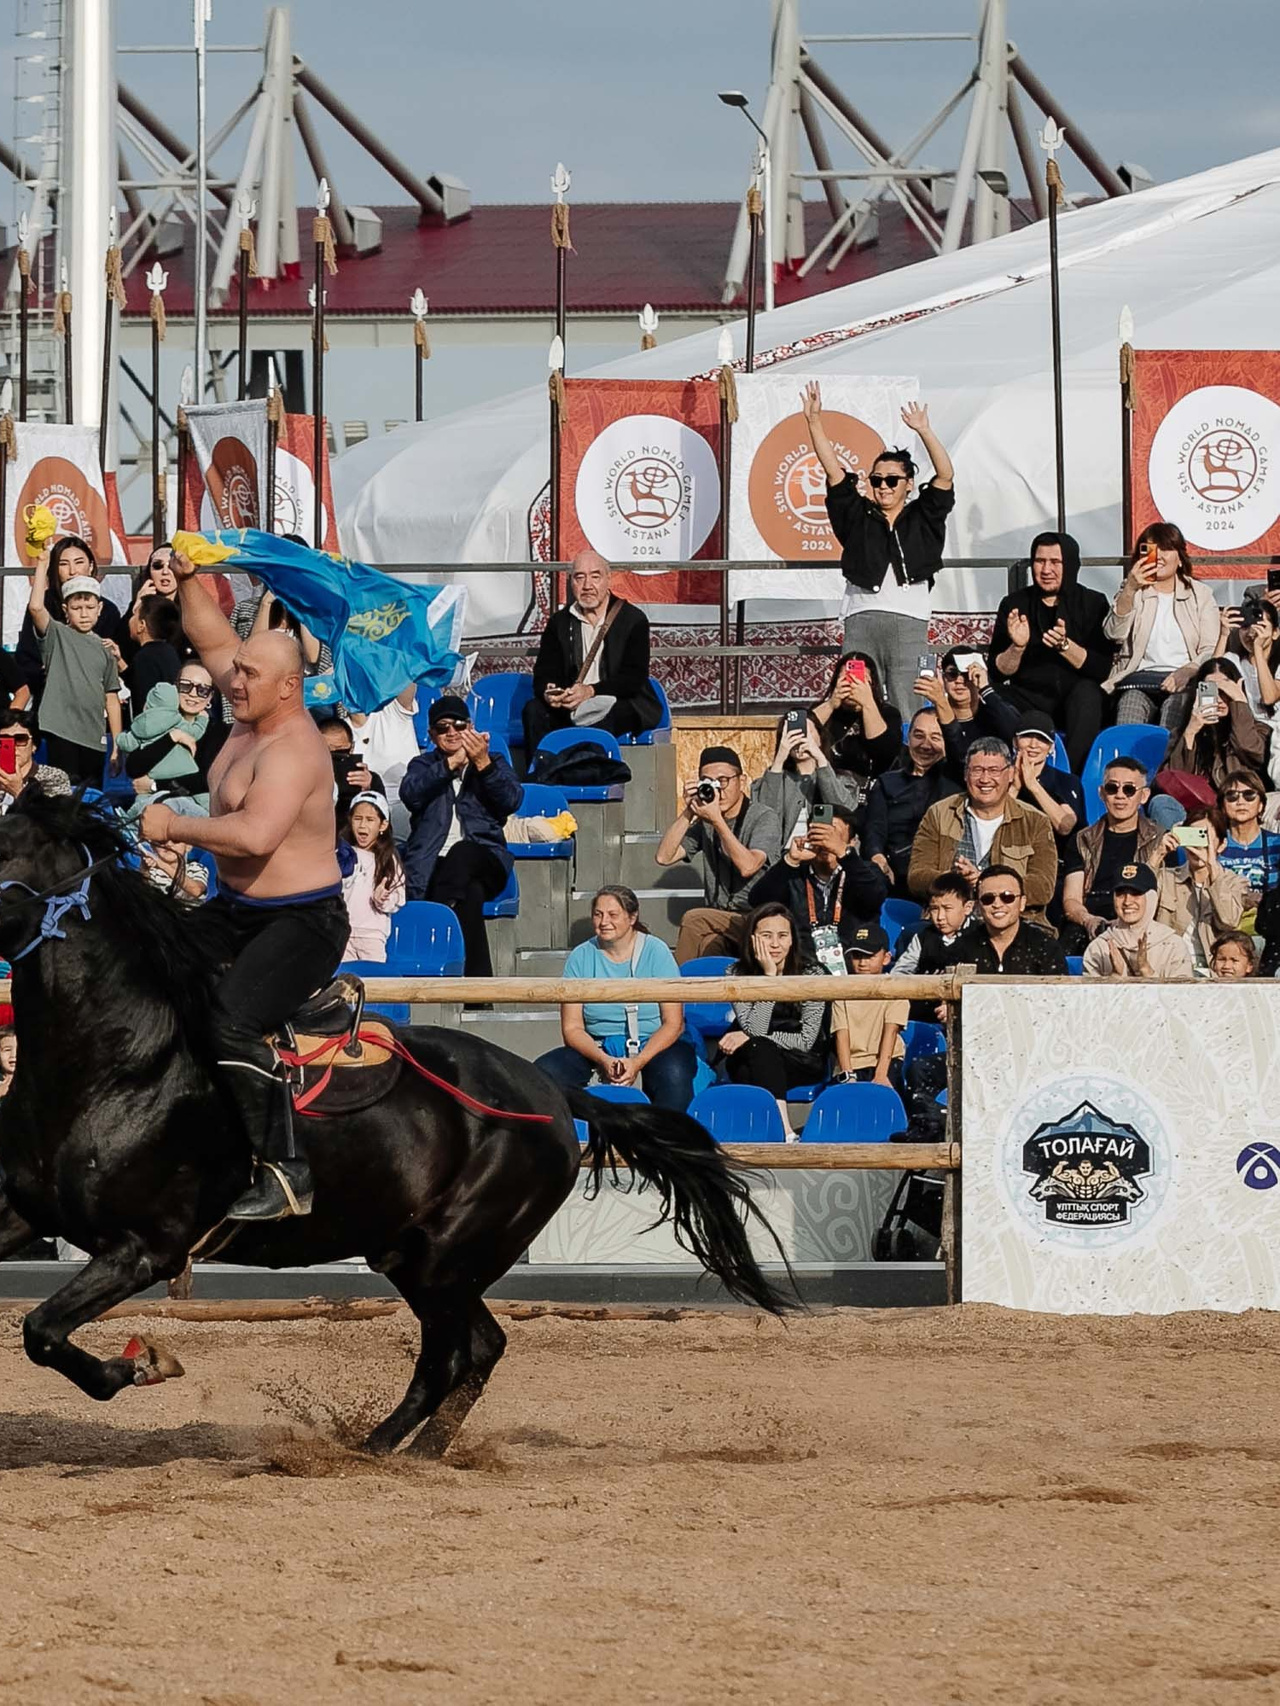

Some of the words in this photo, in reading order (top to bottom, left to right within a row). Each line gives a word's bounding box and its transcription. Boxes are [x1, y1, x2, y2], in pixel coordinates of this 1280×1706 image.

[1215, 418, 1260, 442] NOMAD
[830, 441, 859, 465] MAD
[1177, 422, 1209, 465] WORLD
[642, 446, 685, 471] NOMAD
[774, 443, 808, 485] WORLD
[604, 450, 636, 490] WORLD
[1253, 446, 1269, 494] GAMES
[1177, 471, 1190, 493] 5th
[50, 484, 80, 507] NOMAD
[680, 475, 692, 522] GAMES
[774, 491, 788, 513] 5th
[604, 497, 618, 518] 5th
[1197, 501, 1245, 515] ASTANA
[624, 527, 671, 540] ASTANA
[793, 521, 834, 536] ASTAN
[1205, 521, 1235, 531] 2024
[632, 545, 661, 556] 2024
[801, 540, 833, 551] 2024
[1038, 1137, 1136, 1159] ТОЛАҒАЙ
[1090, 1203, 1120, 1212] СПОРТ
